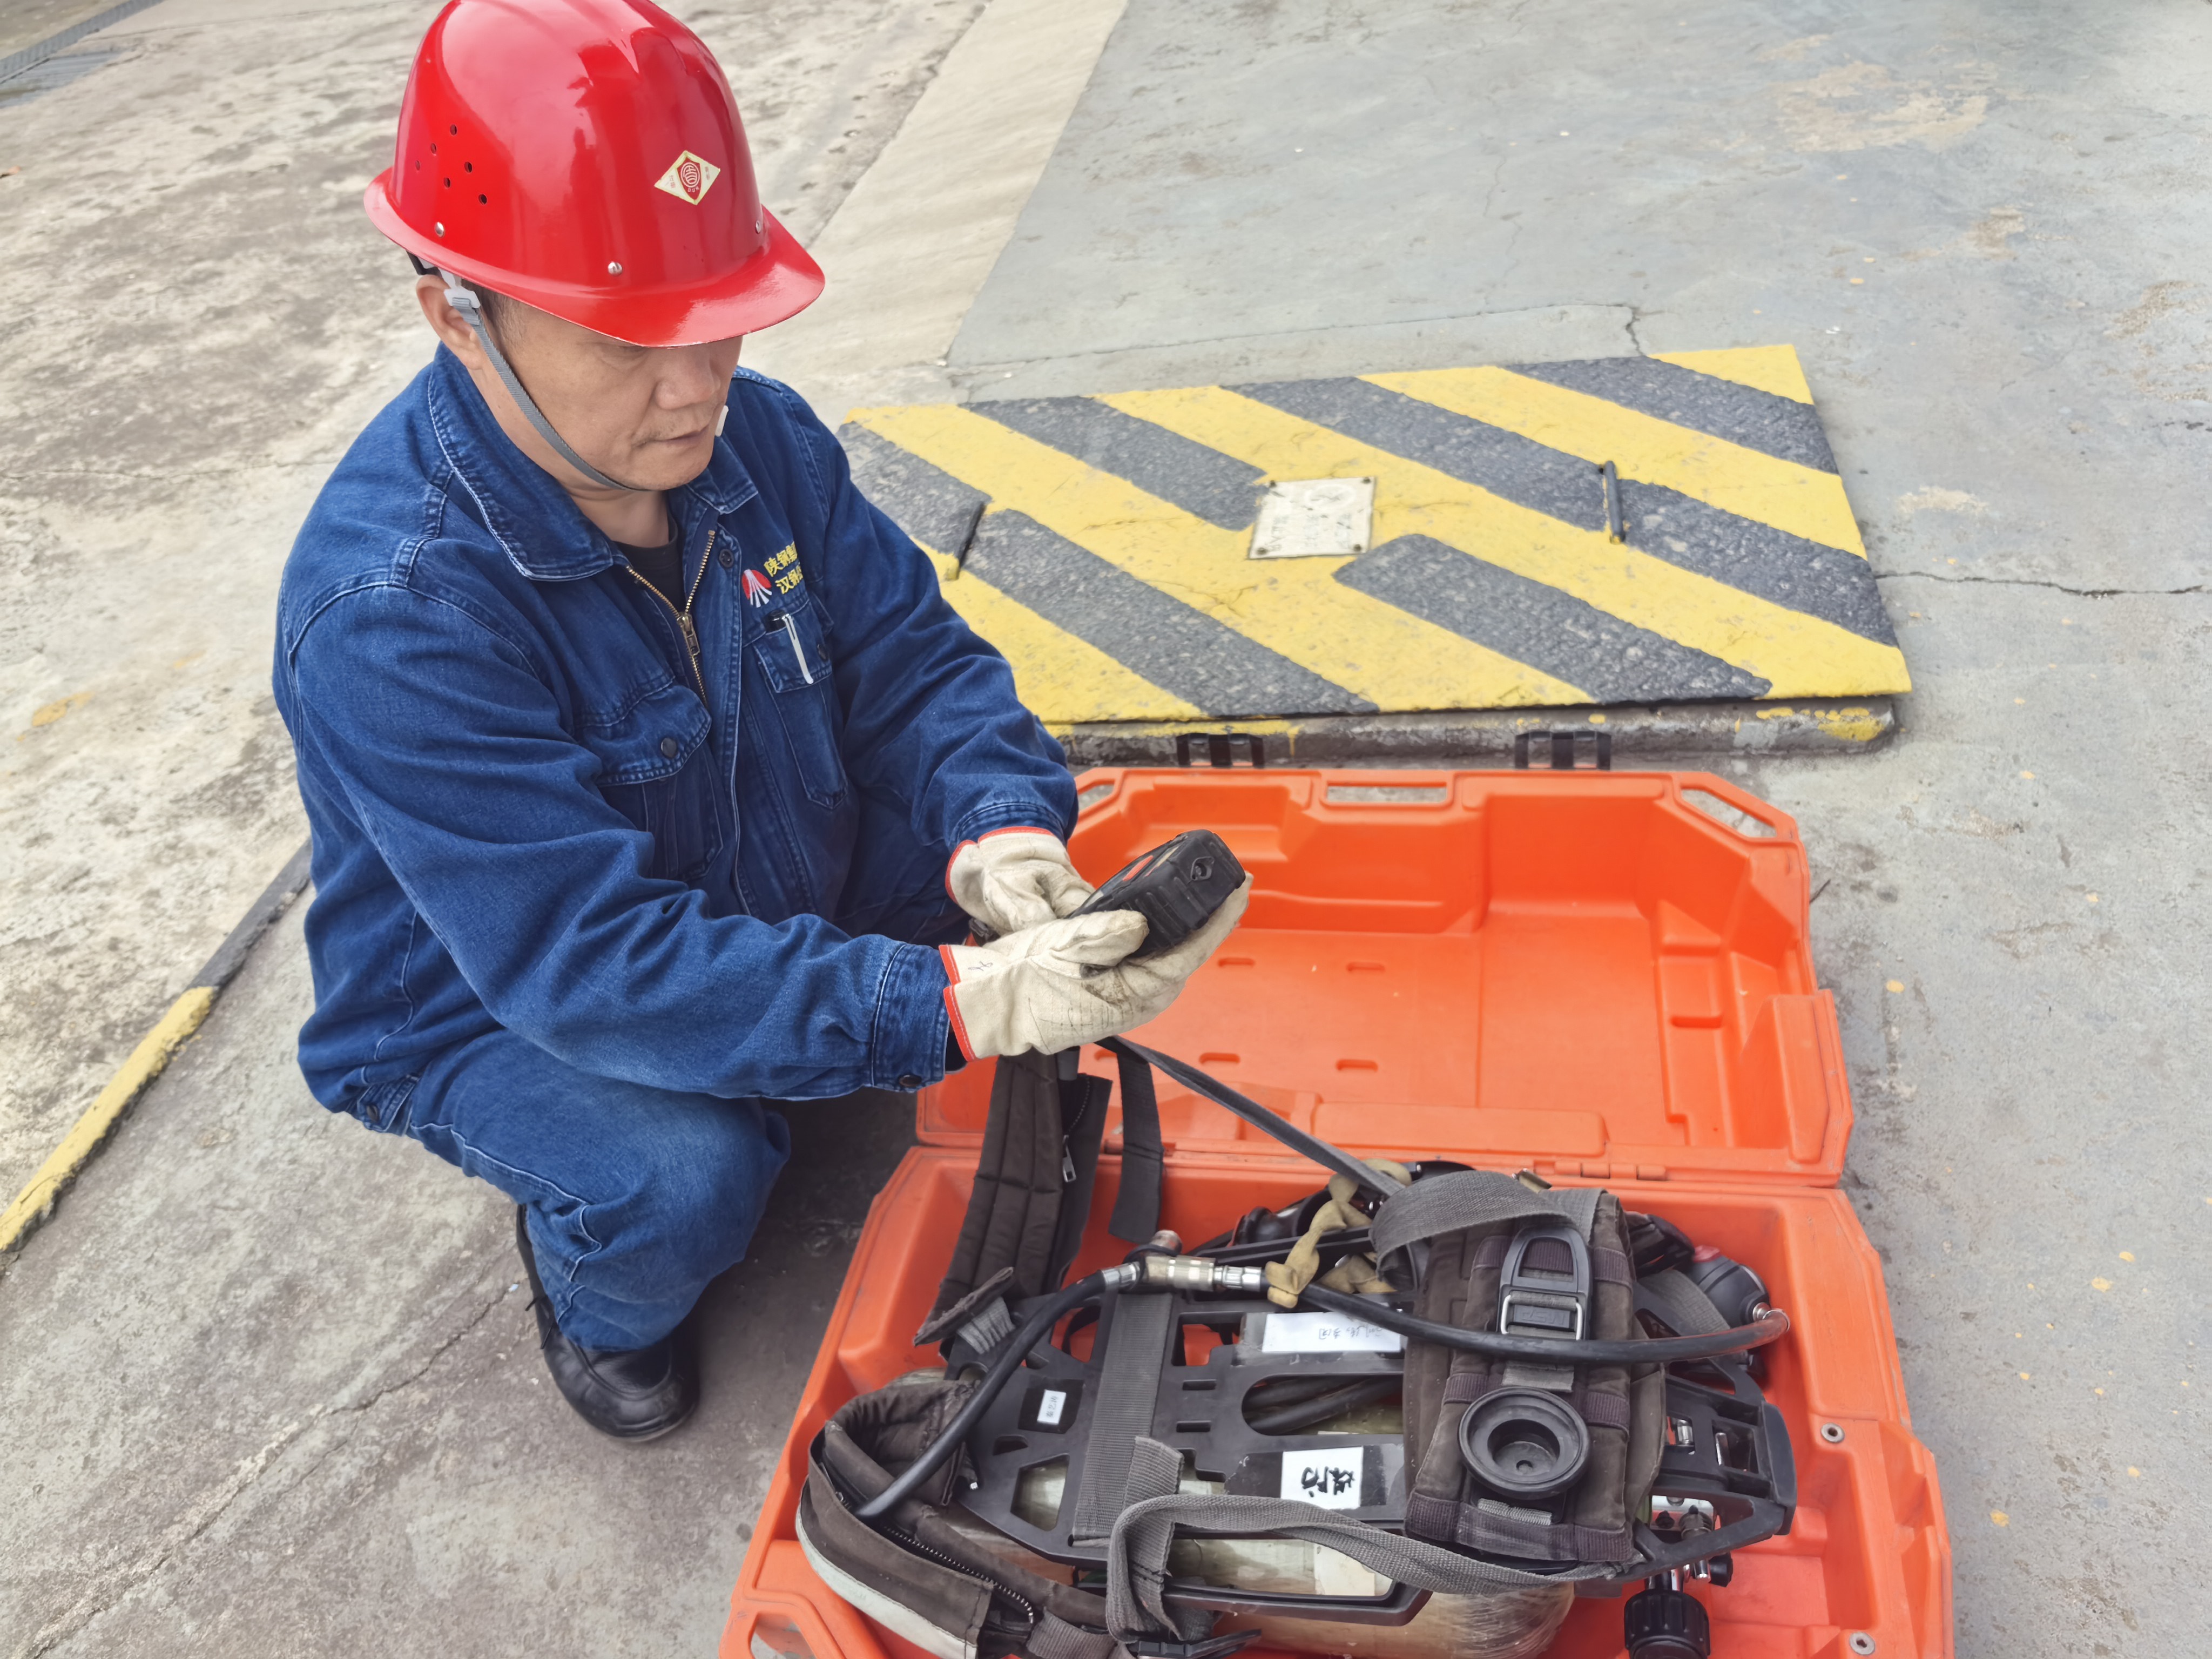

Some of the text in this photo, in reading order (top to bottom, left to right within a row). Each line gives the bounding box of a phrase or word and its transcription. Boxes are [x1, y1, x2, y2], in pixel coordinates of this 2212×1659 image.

[764, 541, 798, 577] 陕钢集
[774, 561, 804, 594] 汉钢公
